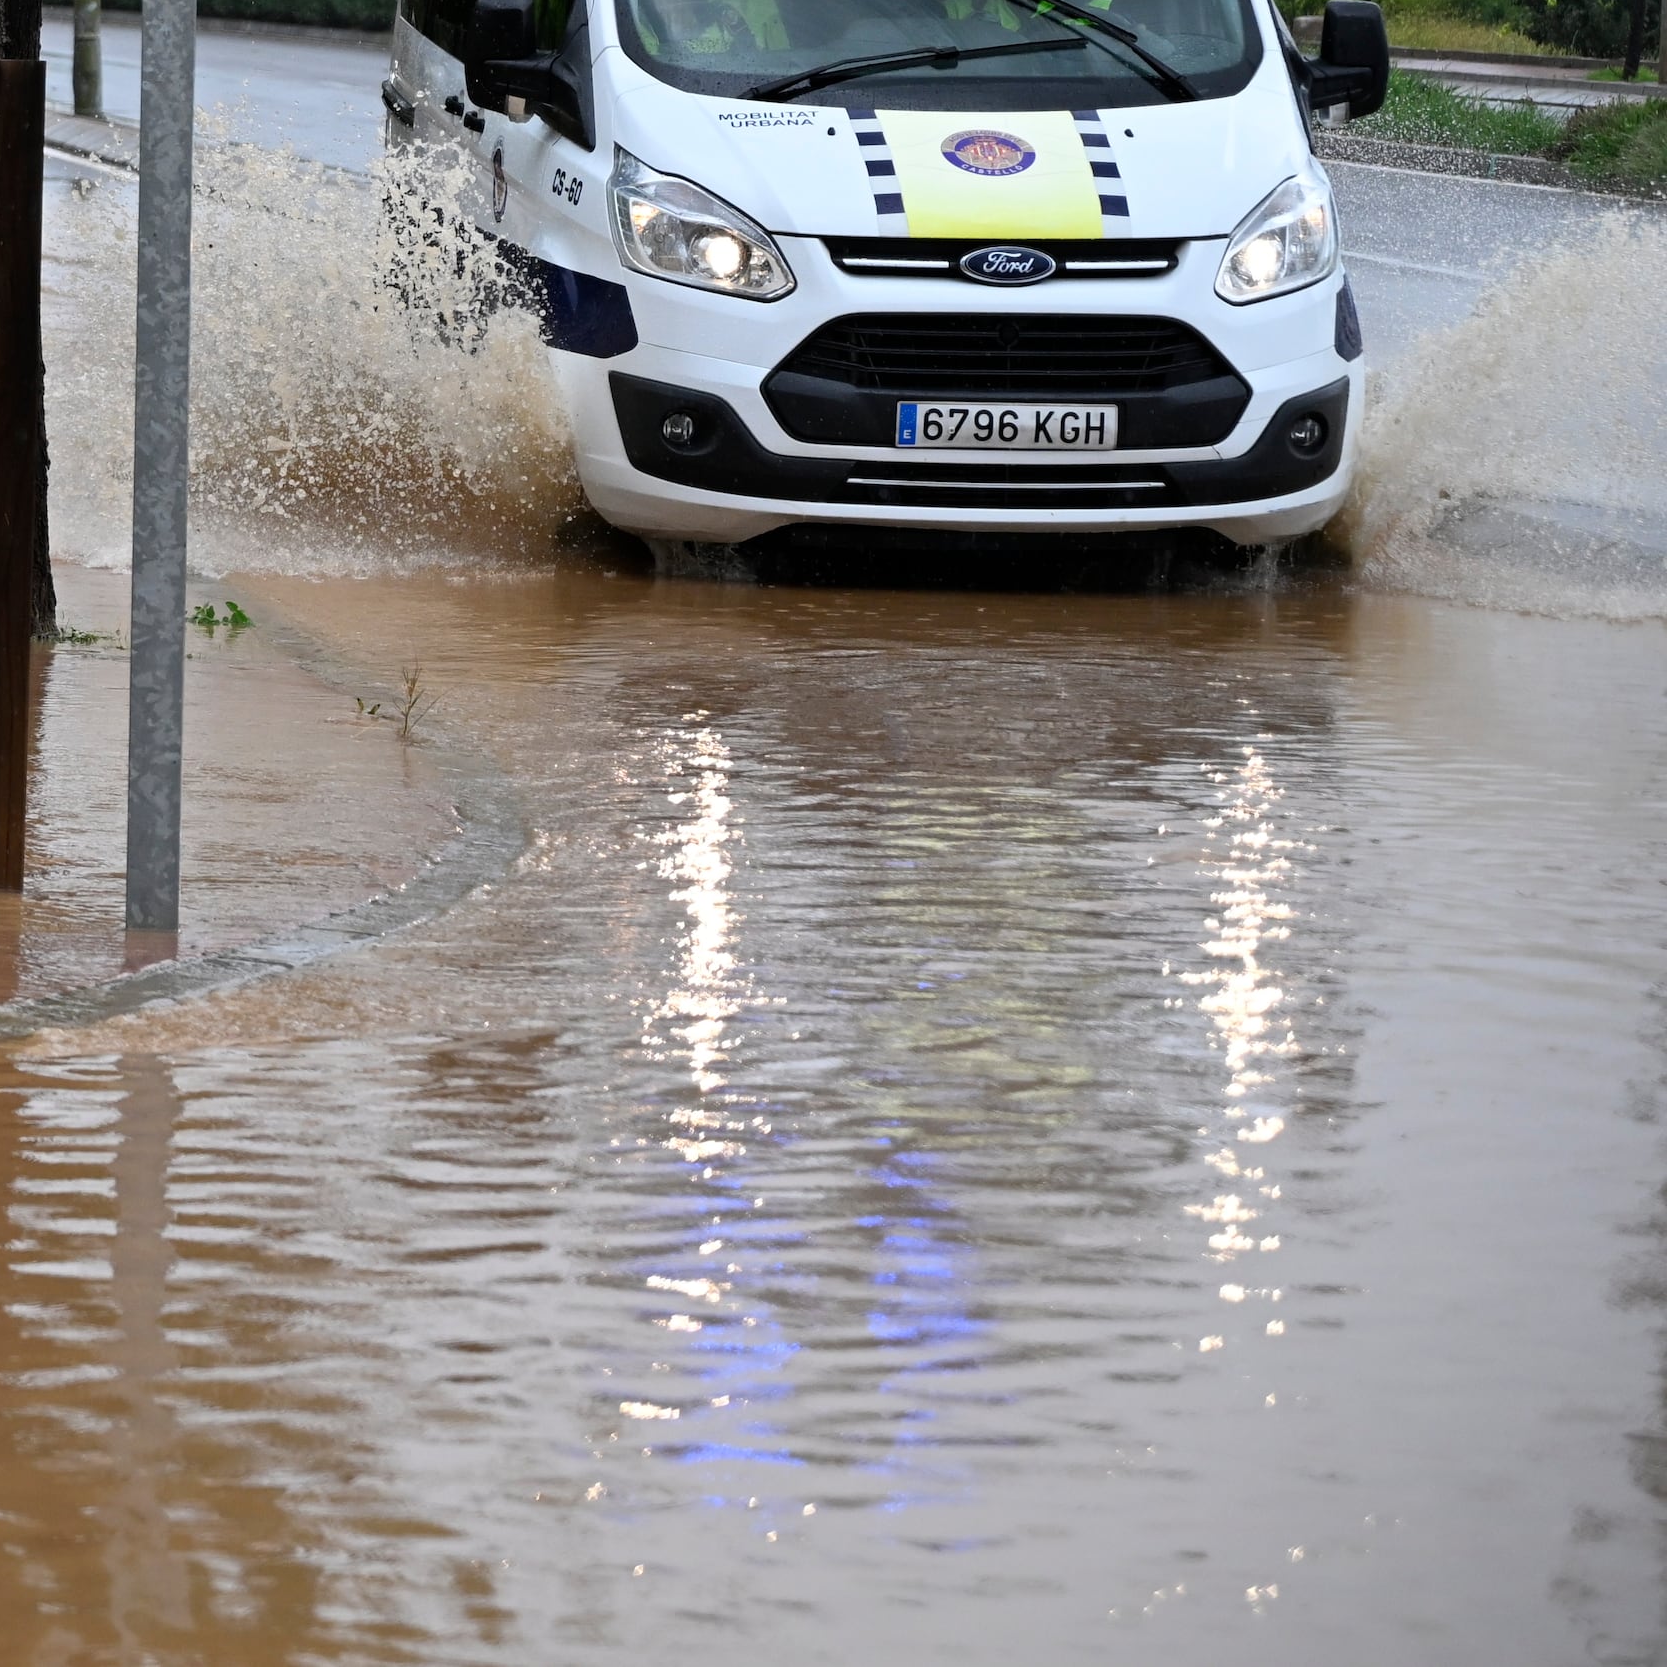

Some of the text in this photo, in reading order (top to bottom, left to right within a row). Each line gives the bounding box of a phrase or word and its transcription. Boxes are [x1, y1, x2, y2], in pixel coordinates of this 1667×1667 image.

[718, 111, 819, 121] MOBILITAT
[730, 119, 814, 128] URBANA
[552, 167, 583, 206] CS-60
[982, 251, 1035, 273] Ford
[903, 408, 1105, 444] E 6796 KGH
